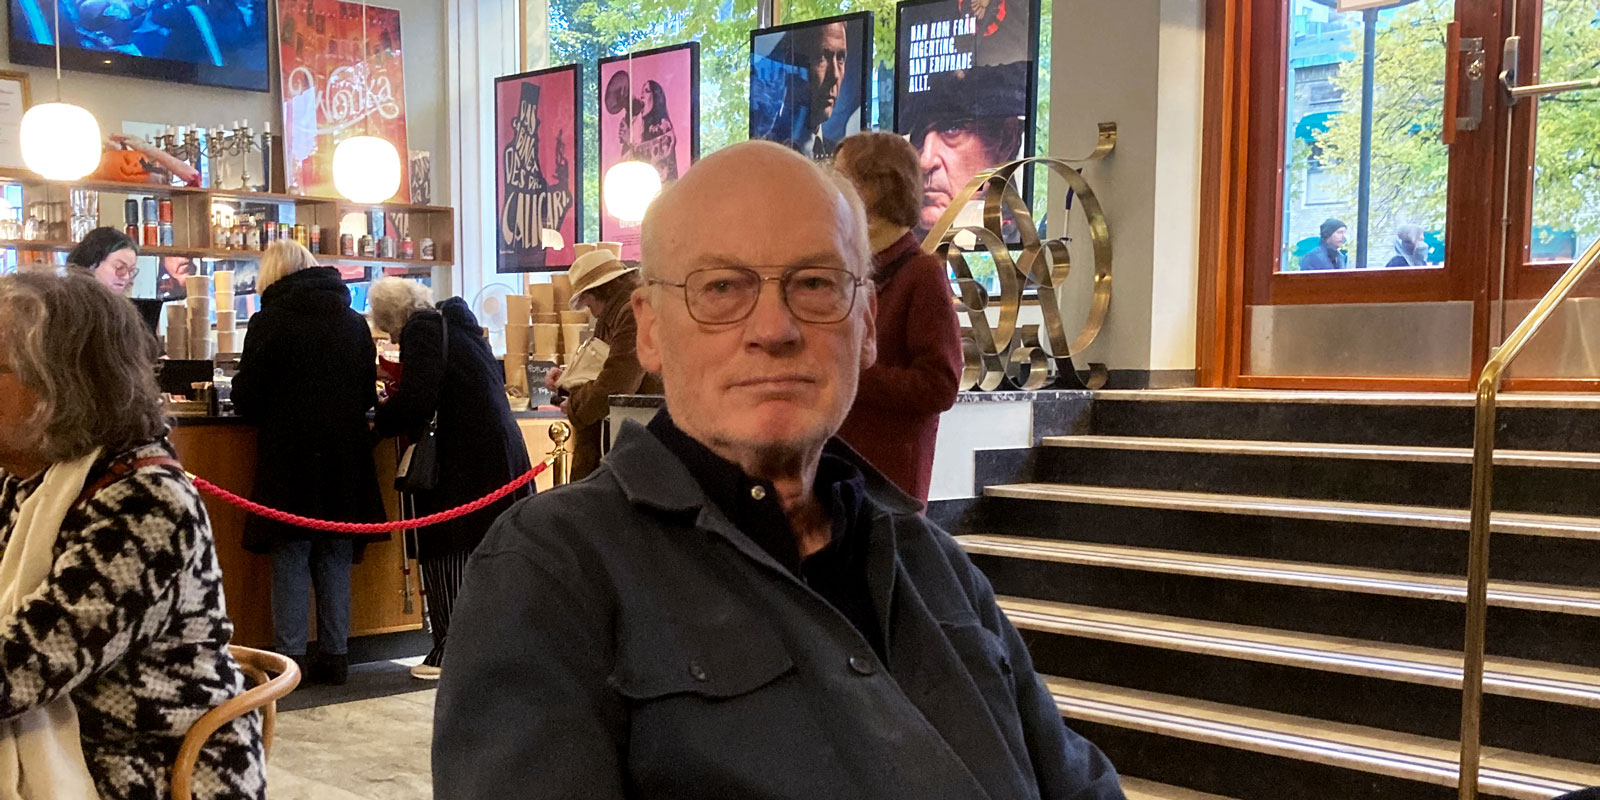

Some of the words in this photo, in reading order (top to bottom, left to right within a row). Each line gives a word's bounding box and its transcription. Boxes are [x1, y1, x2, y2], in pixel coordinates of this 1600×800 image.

[930, 21, 950, 39] KOM
[953, 14, 976, 36] FRÅN
[910, 37, 957, 59] INGENTING.
[288, 62, 399, 134] Wonka
[908, 75, 931, 93] ALLT.
[520, 100, 537, 135] DAS
[505, 147, 526, 188] DES
